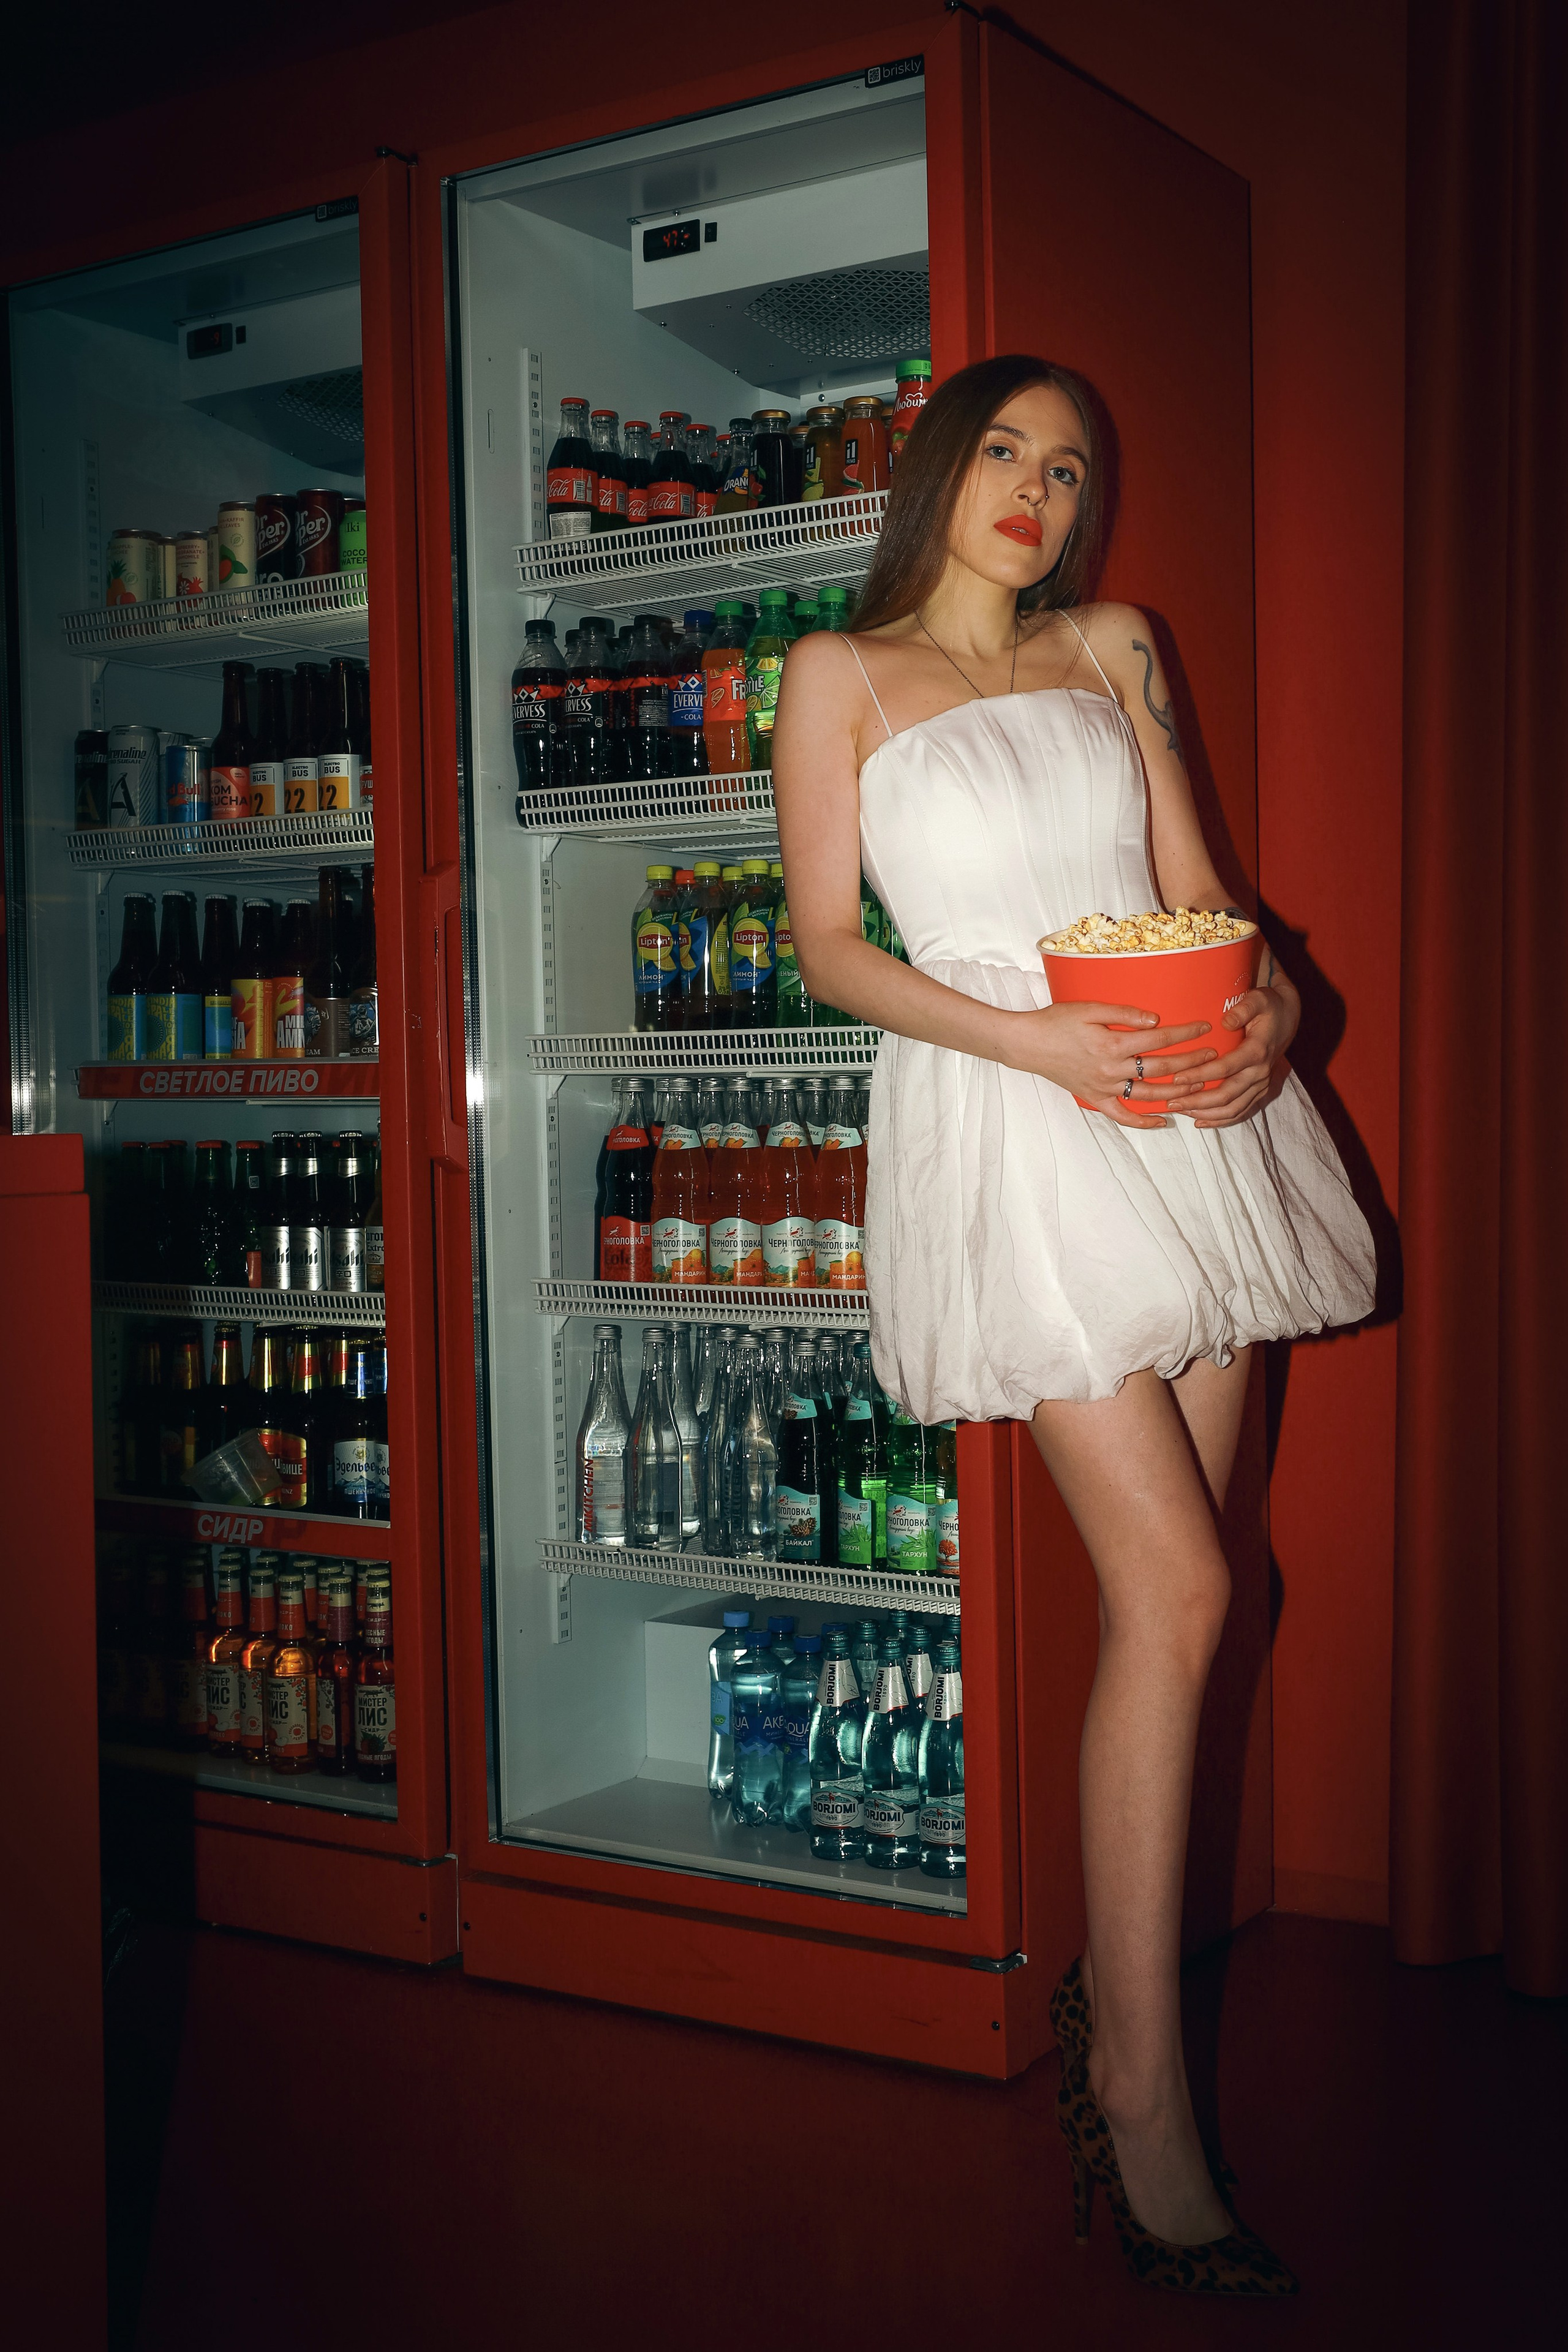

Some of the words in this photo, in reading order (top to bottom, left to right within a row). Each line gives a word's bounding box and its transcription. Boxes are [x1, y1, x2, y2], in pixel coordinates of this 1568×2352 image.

[883, 59, 921, 78] briskly
[328, 199, 358, 214] briskly
[347, 522, 360, 533] Iki
[342, 549, 366, 557] COCO
[565, 697, 592, 712] ERVESS
[736, 933, 763, 943] Lipton
[775, 933, 791, 943] Lipto
[139, 1070, 245, 1093] СВЕТЛОЕ
[249, 1069, 318, 1092] ПИВО
[769, 1238, 814, 1248] ЧЕРНОГОЛОВ
[335, 1457, 375, 1476] Эдельве
[584, 1458, 594, 1532] MKITCHEN
[197, 1514, 263, 1544] СИДР
[938, 1520, 959, 1531] ЧЕРНО
[827, 1664, 836, 1705] BORJOMI
[873, 1670, 884, 1711] BORJOMI
[358, 1697, 387, 1707] МИСТЕР
[934, 1676, 944, 1719] BORJOMI
[358, 1706, 387, 1726] ЛИС
[813, 1802, 856, 1814] BORJOMI
[921, 1816, 965, 1831] BORJOMI
